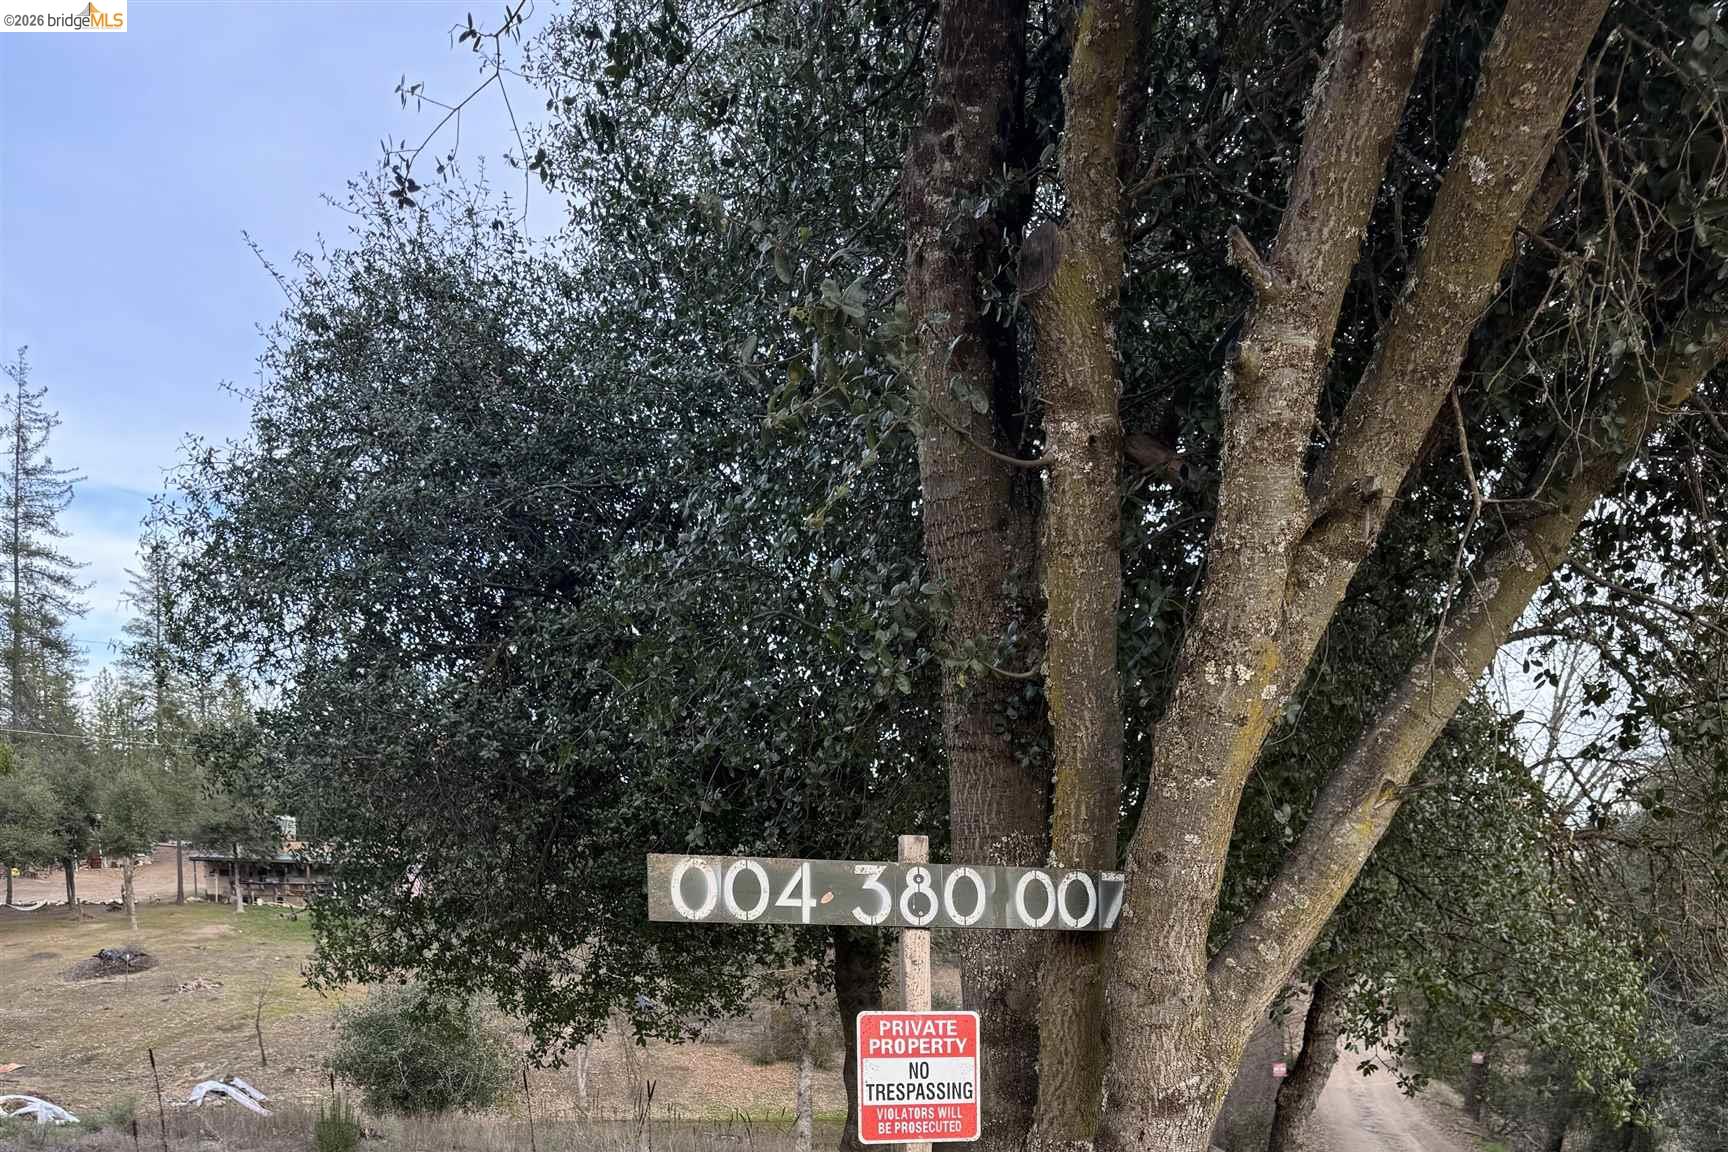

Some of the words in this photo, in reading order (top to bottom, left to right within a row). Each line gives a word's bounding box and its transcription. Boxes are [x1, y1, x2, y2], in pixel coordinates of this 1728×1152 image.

[670, 857, 817, 922] 004
[852, 864, 987, 927] 380
[879, 1019, 957, 1036] PRIVATE
[869, 1037, 967, 1054] PROPERTY
[909, 1061, 929, 1079] NO
[865, 1082, 973, 1101] TRESPASSING
[876, 1107, 934, 1120] VIOLATORS
[937, 1106, 963, 1119] WILL
[878, 1121, 892, 1135] BE
[894, 1120, 962, 1134] PROSECUTED
